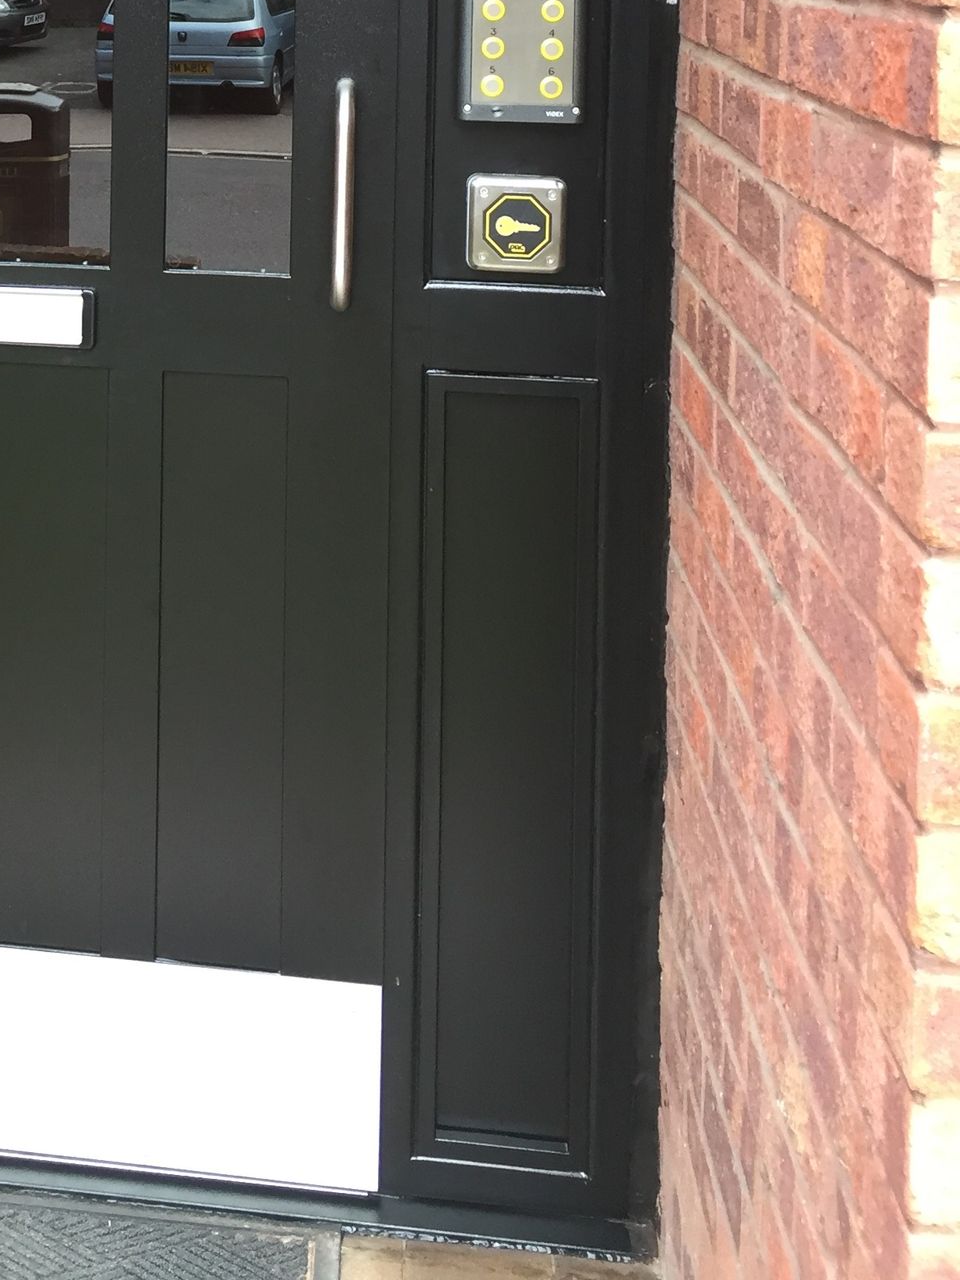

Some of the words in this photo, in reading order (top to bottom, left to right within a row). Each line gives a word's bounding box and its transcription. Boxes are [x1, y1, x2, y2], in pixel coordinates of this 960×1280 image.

[490, 28, 497, 36] 3
[548, 29, 555, 37] 4
[548, 67, 555, 75] 6
